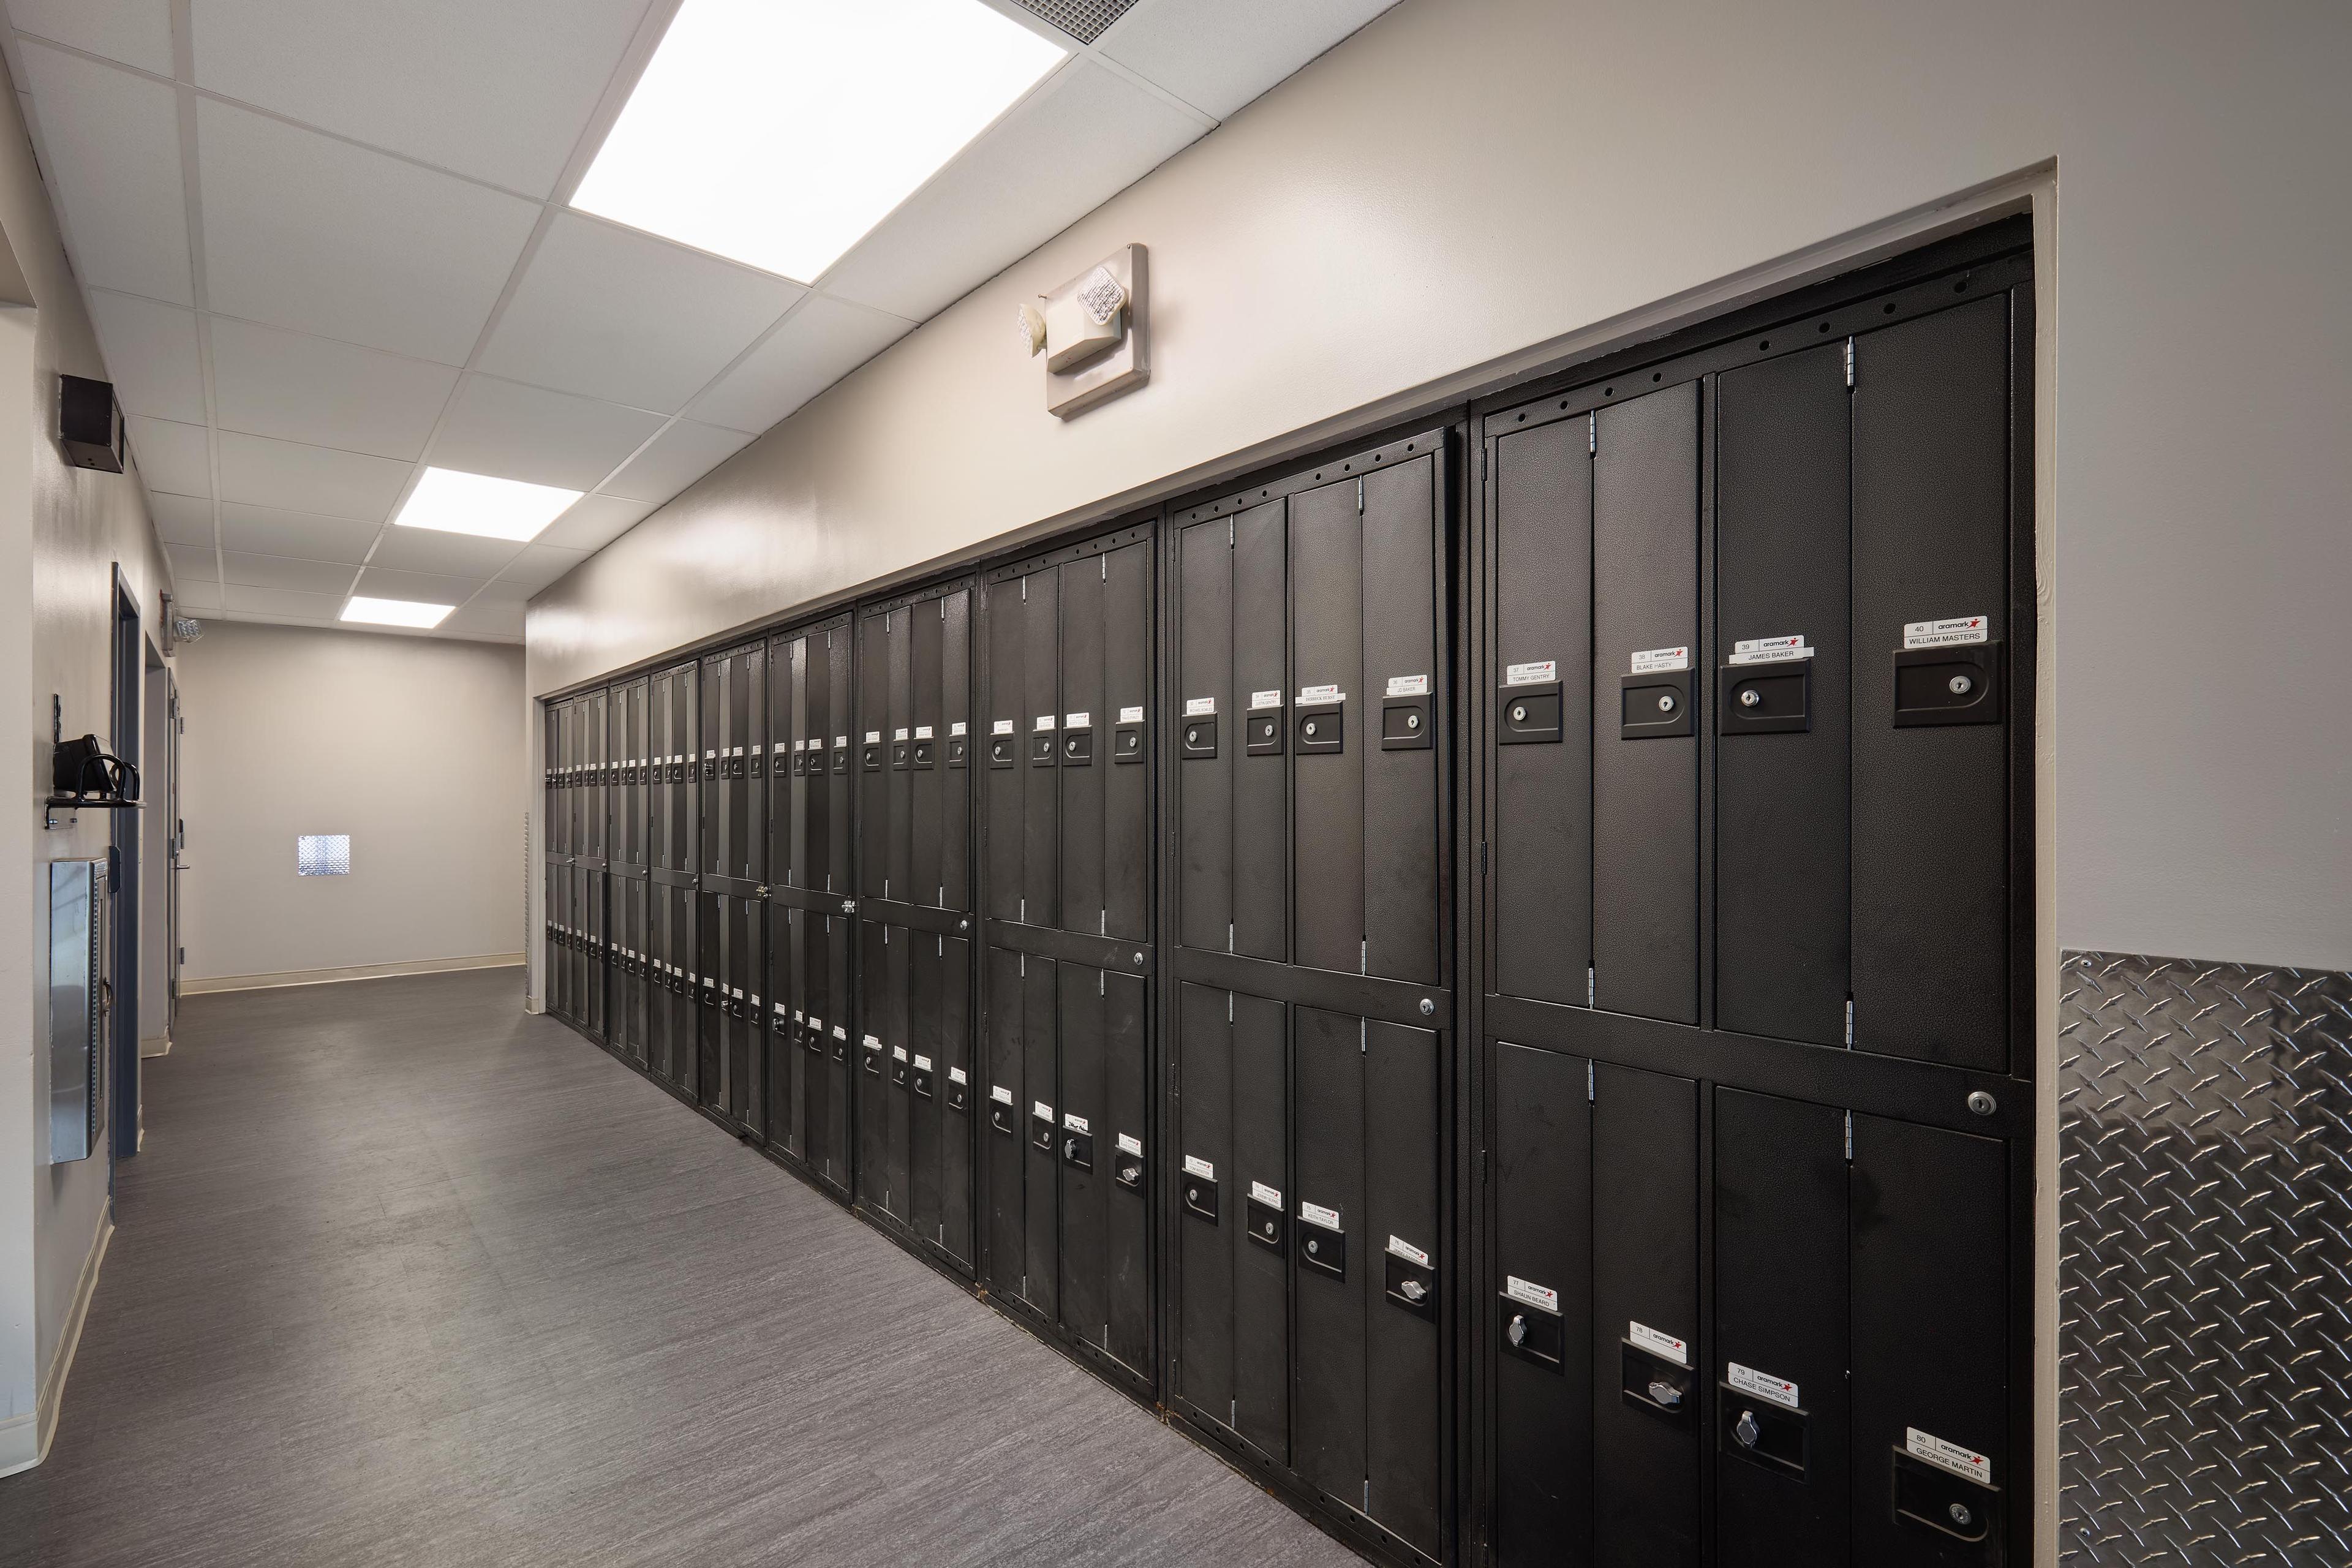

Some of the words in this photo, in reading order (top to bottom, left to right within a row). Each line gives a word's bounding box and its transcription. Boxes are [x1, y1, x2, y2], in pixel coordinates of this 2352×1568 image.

[1405, 1246, 1420, 1256] aramark
[1528, 1286, 1547, 1295] aramark
[1513, 1290, 1531, 1300] SHAUN
[1532, 1297, 1550, 1306] BEARD
[1653, 1333, 1674, 1345] aramark
[1757, 1376, 1782, 1388] aramark
[1733, 1377, 1760, 1390] CHASE
[1758, 1385, 1790, 1402] SIMPSON
[1917, 1434, 1926, 1443] 80
[1940, 1444, 1972, 1460] aramark
[1916, 1447, 1950, 1466] GEORGE
[1951, 1461, 1982, 1477] MARTIN
